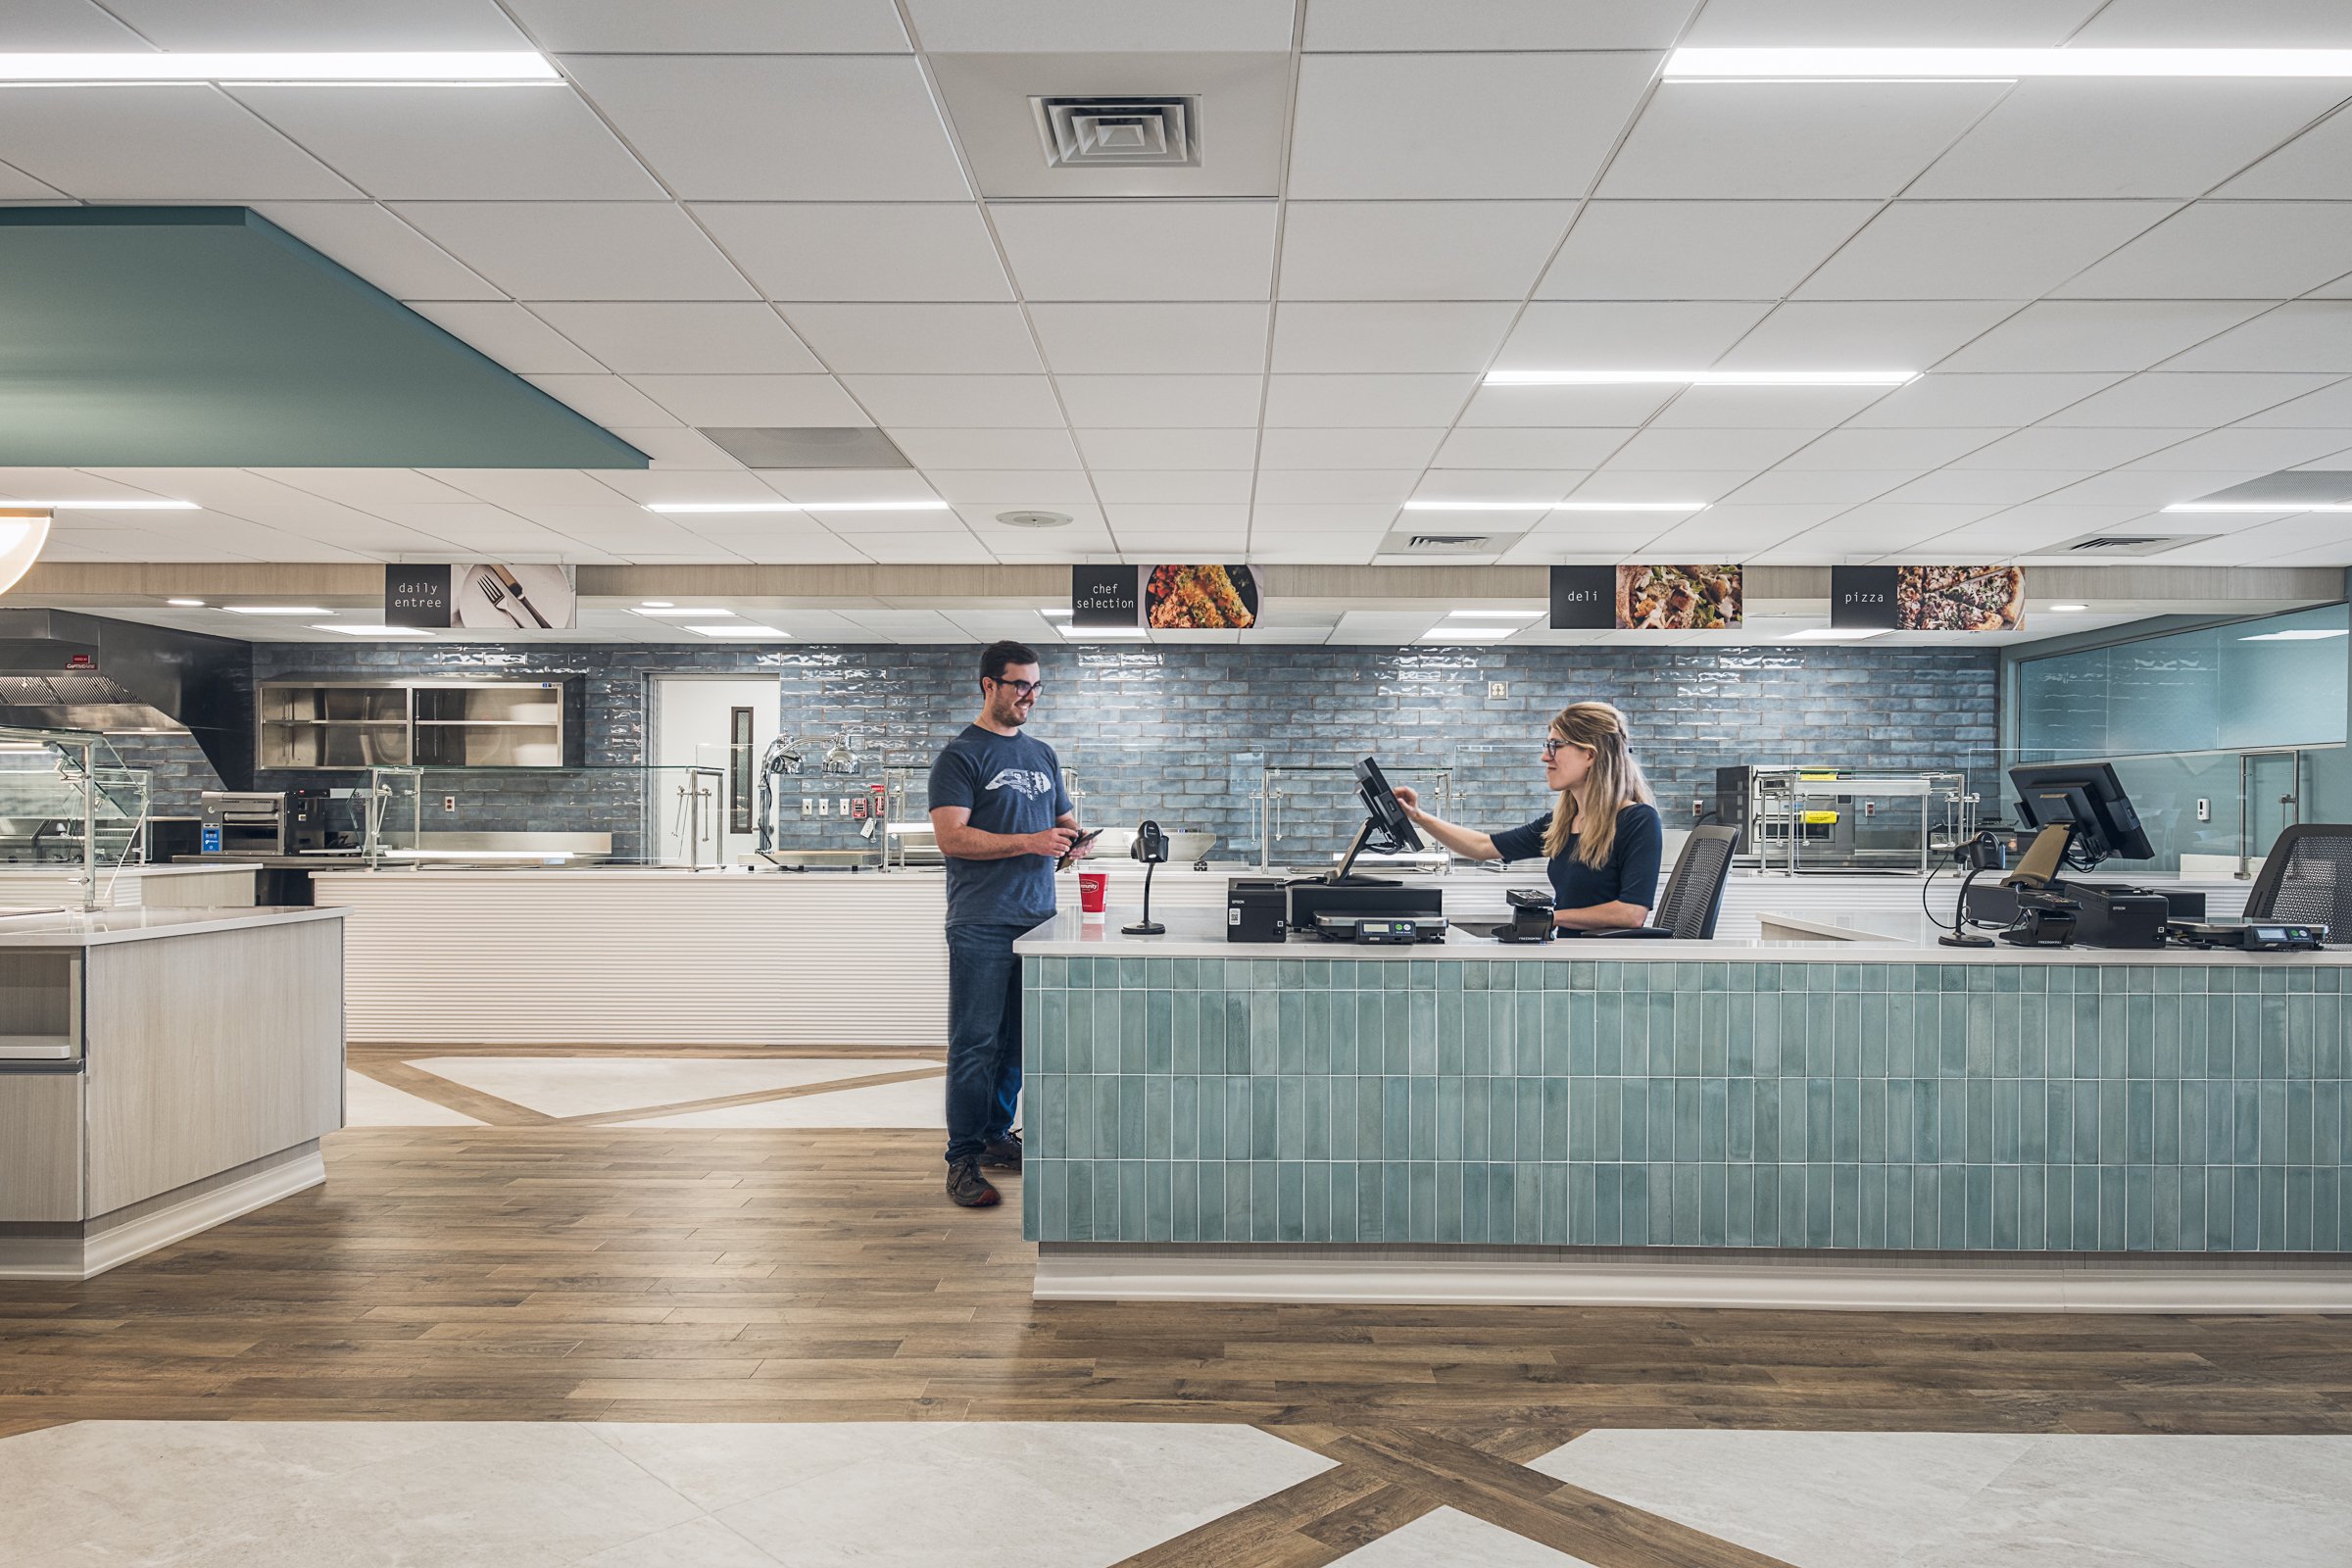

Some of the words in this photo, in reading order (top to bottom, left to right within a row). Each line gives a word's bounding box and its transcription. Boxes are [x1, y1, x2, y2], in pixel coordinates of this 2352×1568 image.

[399, 582, 438, 596] daily
[1093, 583, 1118, 595] chef
[1568, 590, 1598, 602] deli
[1845, 592, 1884, 605] pizza
[394, 597, 442, 608] entree
[1077, 597, 1134, 609] selection
